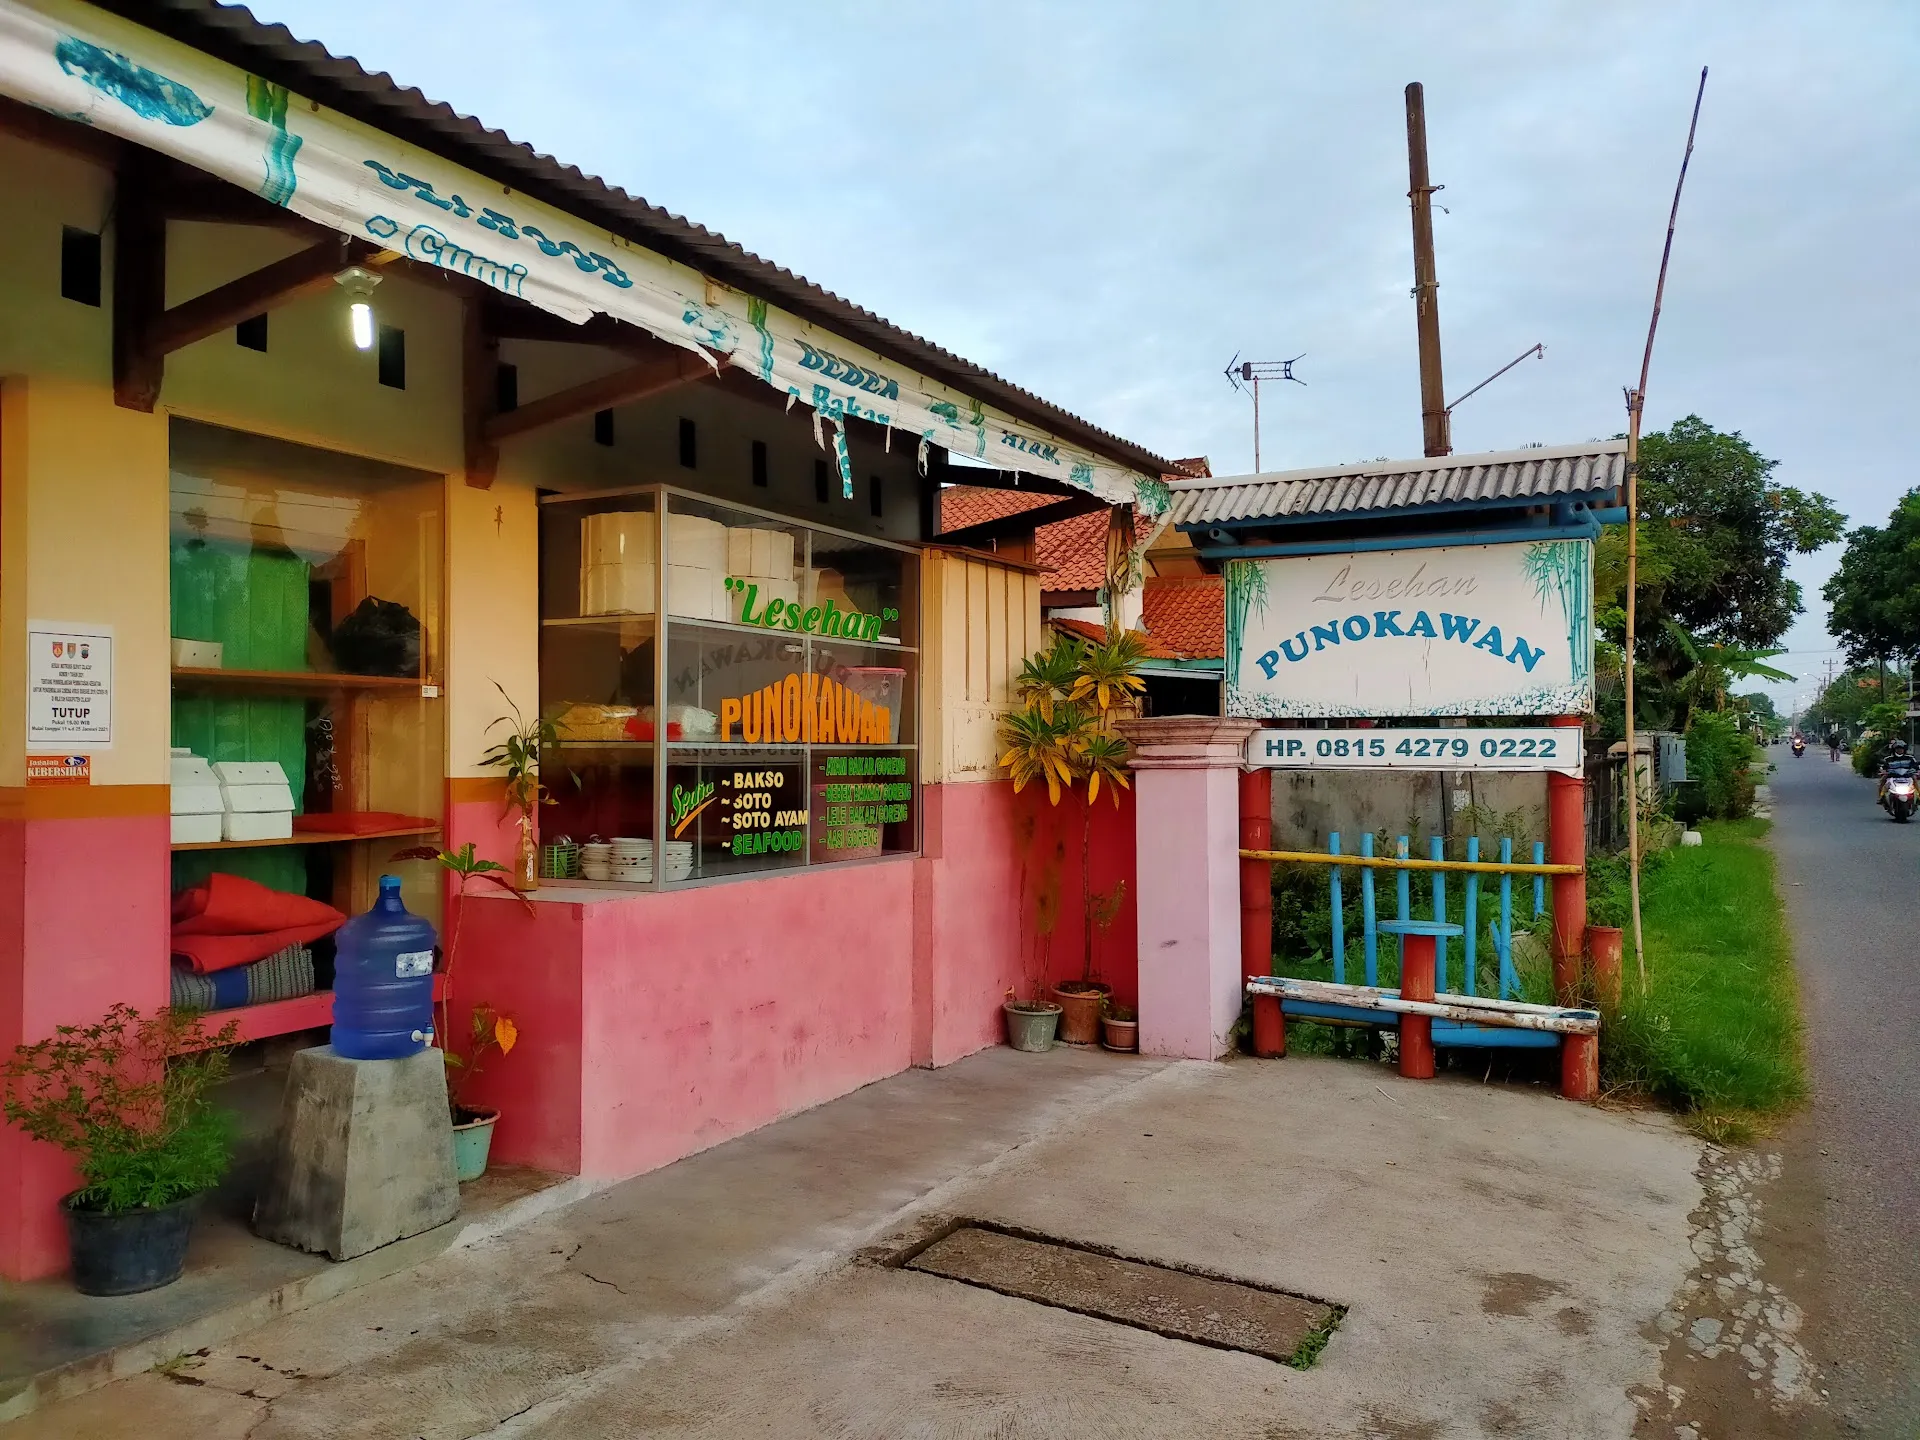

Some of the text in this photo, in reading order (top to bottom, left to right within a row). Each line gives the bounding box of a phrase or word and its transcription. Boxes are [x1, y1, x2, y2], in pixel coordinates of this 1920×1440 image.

[1312, 562, 1479, 602] Lesehan
[1255, 610, 1545, 680] PUNOKAWAN
[52, 707, 90, 718] TUTUP
[721, 673, 890, 744] PUNOKAWAN
[1265, 738, 1557, 758] HP. 0815 4279 0222
[28, 767, 89, 777] KEBERSIHAN
[734, 771, 784, 789] BAKSO
[733, 793, 772, 809] SOTO
[826, 784, 852, 802] BEBEK
[733, 810, 808, 829] SOTO AYAM
[827, 806, 846, 827] LELE
[732, 830, 802, 856] SEAFOOD
[827, 828, 878, 849] NASI GORENG
